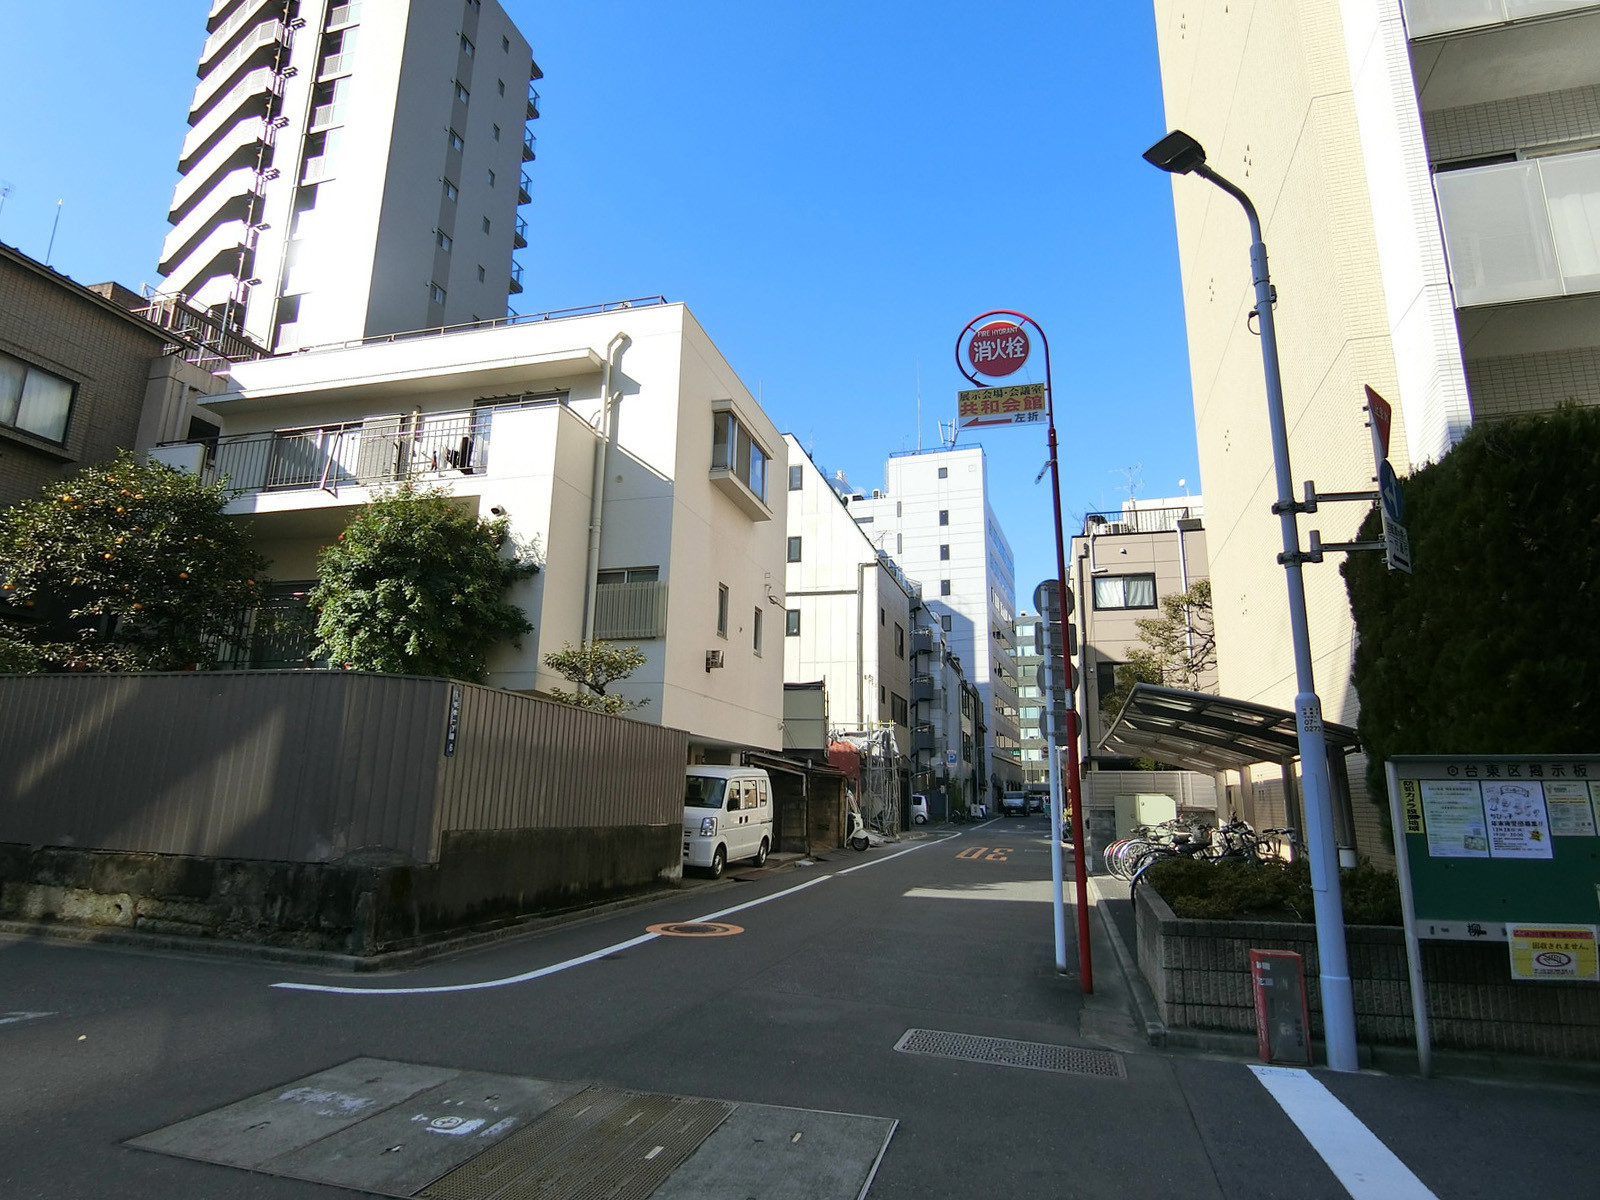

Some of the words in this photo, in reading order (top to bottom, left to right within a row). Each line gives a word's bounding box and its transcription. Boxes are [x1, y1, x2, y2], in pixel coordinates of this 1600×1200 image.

[977, 329, 991, 338] FIRE
[991, 326, 1018, 337] HYDRANT
[973, 336, 1025, 363] 消火栓
[960, 396, 1043, 415] 共和会館
[1014, 411, 1039, 424] 左折
[1464, 763, 1589, 778] 台東区掲示板
